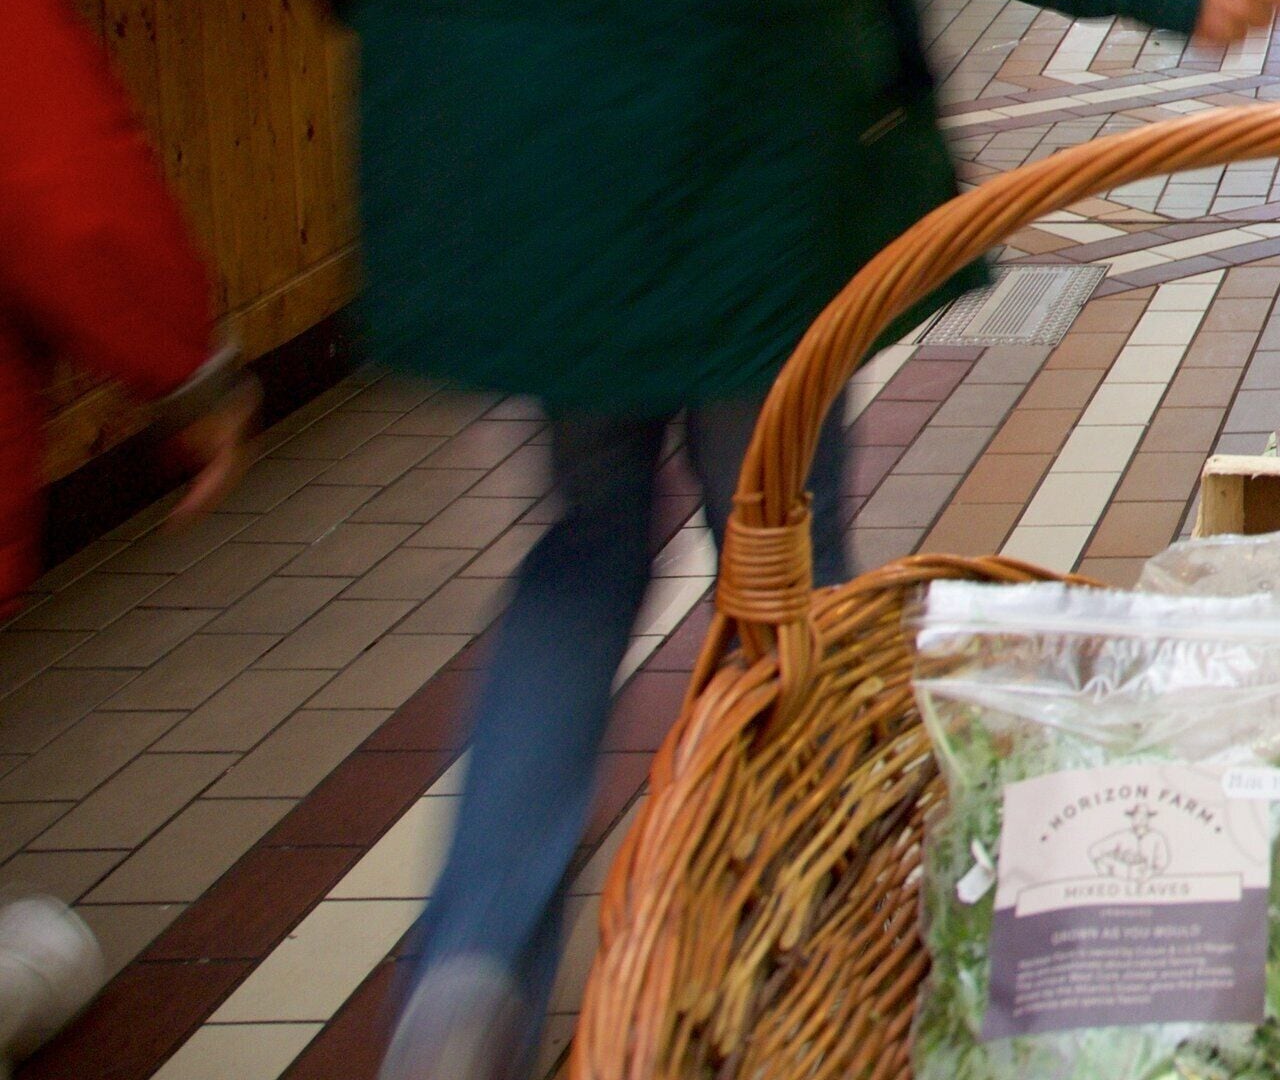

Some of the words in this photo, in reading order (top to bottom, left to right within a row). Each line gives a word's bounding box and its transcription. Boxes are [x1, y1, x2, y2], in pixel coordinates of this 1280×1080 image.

[1051, 785, 1148, 831] HORIZON
[1158, 789, 1215, 825] FARM
[1063, 883, 1119, 899] MIXED
[1125, 882, 1191, 897] LEAVES
